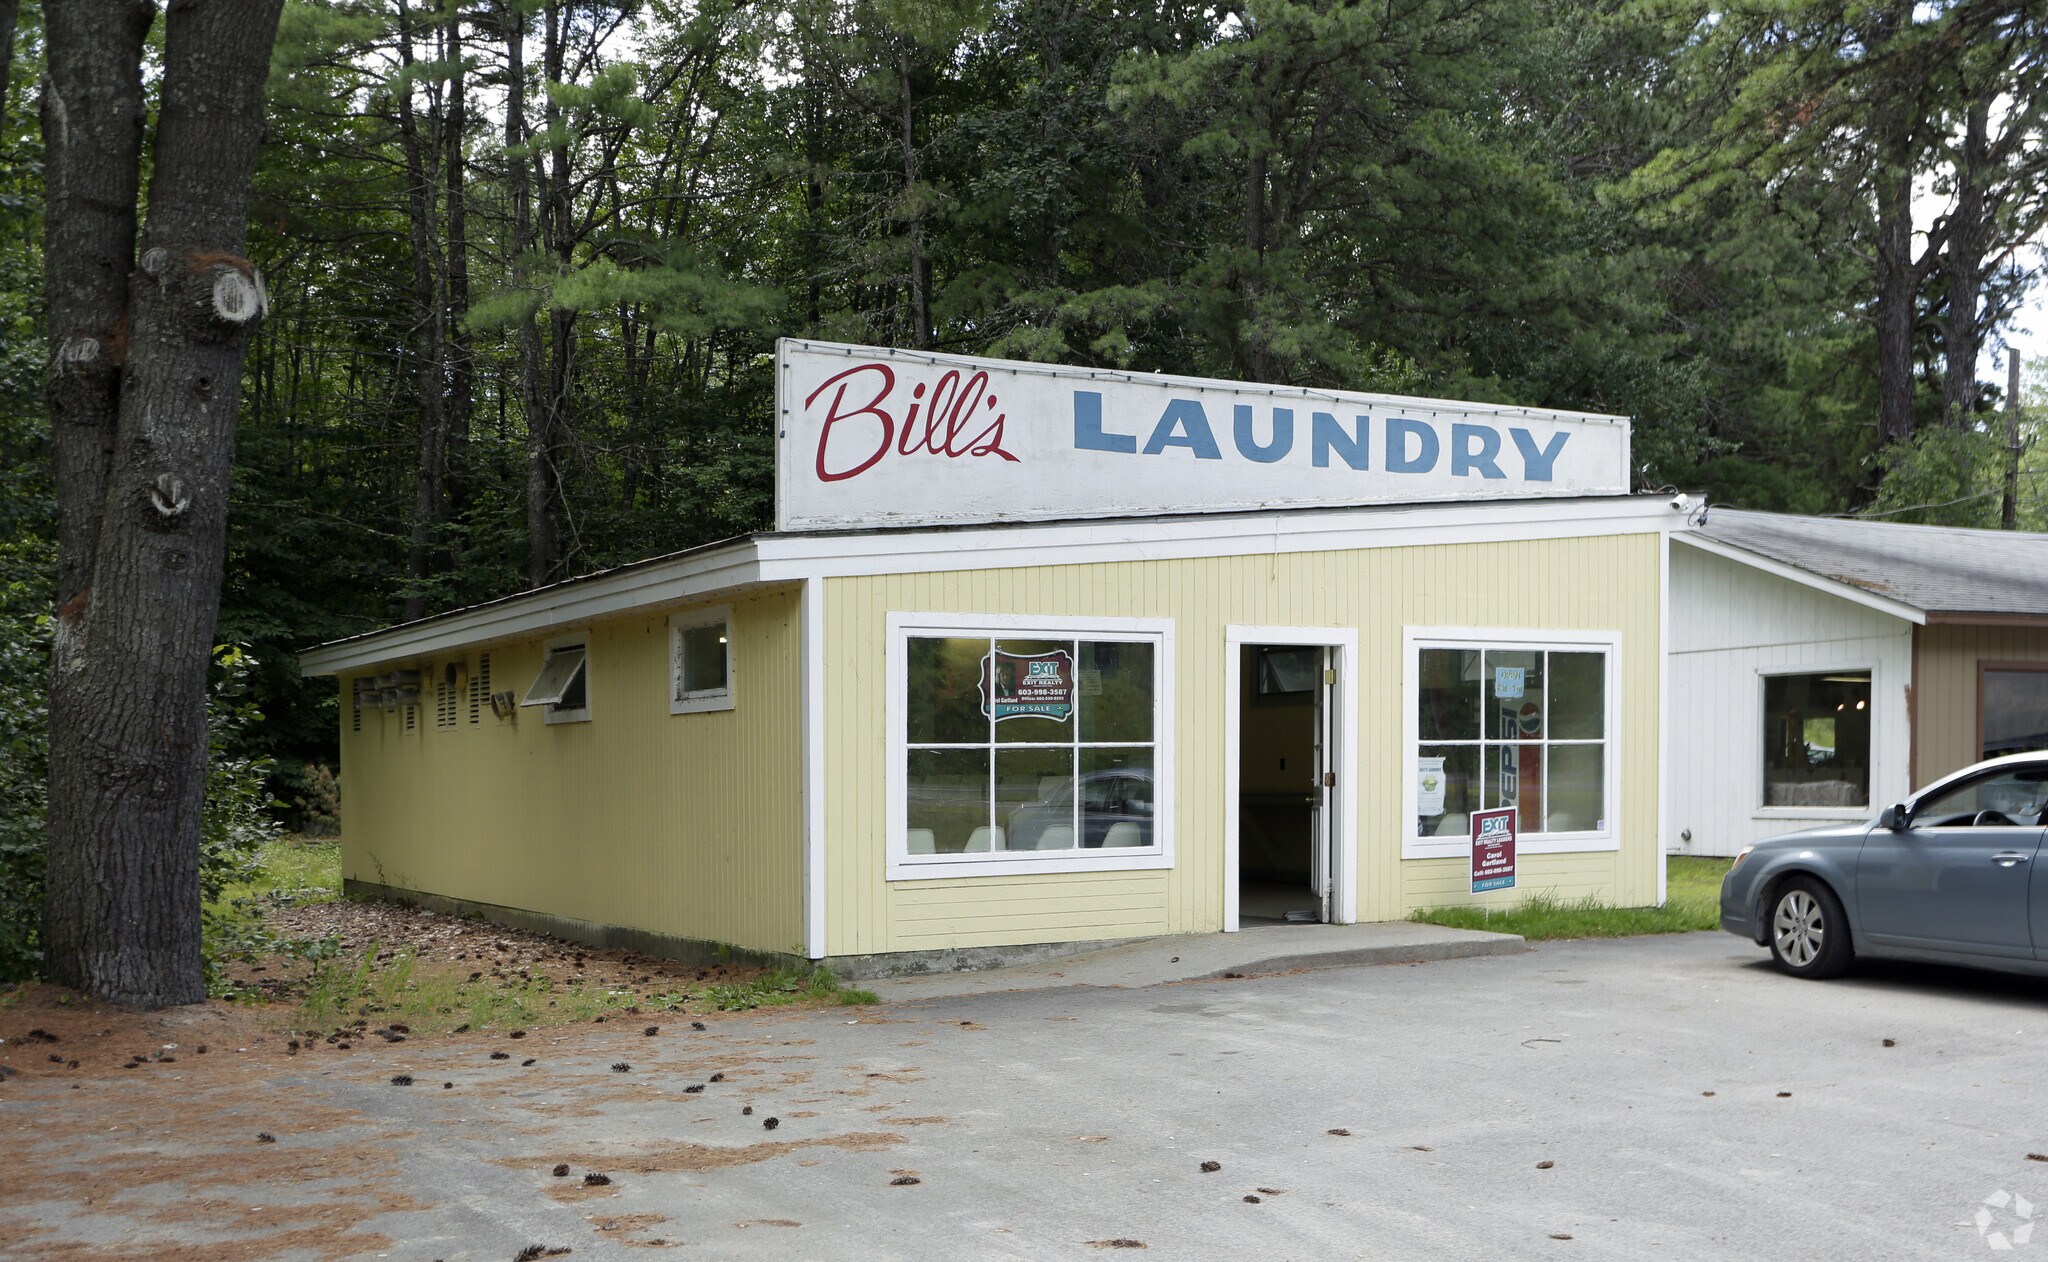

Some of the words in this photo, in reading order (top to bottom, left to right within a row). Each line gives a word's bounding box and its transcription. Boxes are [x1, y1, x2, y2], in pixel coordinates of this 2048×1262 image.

[805, 363, 1021, 482] Bill's
[1073, 390, 1570, 482] LAUNDRY
[1028, 661, 1060, 676] EXIT
[1006, 705, 1026, 713] FOR
[1482, 816, 1509, 834] EXIT
[1486, 851, 1502, 859] Carol
[1481, 857, 1507, 867] Gartland
